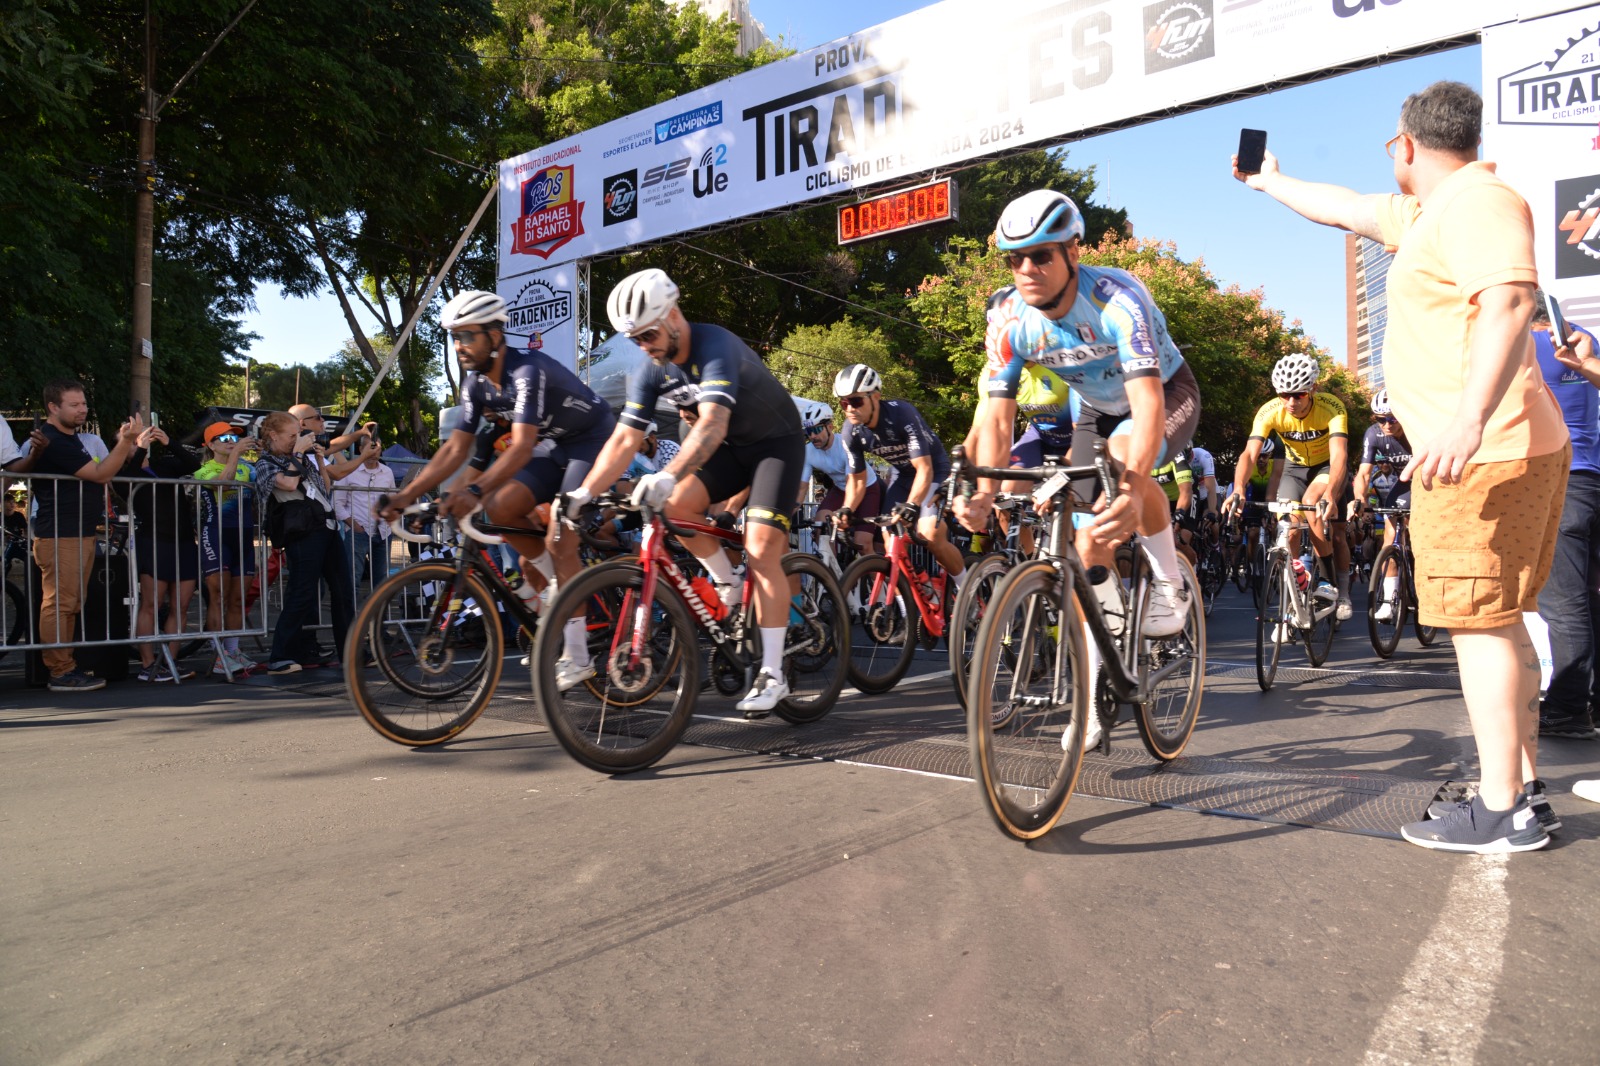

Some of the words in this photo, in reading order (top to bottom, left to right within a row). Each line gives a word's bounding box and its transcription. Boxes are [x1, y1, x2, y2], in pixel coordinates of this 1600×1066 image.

[1581, 53, 1595, 64] 21
[670, 109, 708, 125] PREFEITURA
[670, 111, 720, 136] CAMPINAS
[1552, 105, 1596, 120] CICLISMO
[513, 158, 541, 175] INSTITUTO
[542, 144, 582, 165] EDUCACIONAL
[603, 145, 630, 159] ESPORTES
[635, 137, 653, 148] LAZER
[806, 160, 870, 191] CICLISMO
[979, 117, 1025, 146] 2024
[524, 206, 571, 230] RAPHAEL
[524, 230, 534, 243] DI
[536, 219, 571, 239] SANTO
[1058, 351, 1086, 363] PRO
[664, 563, 726, 644] S-WORKS
